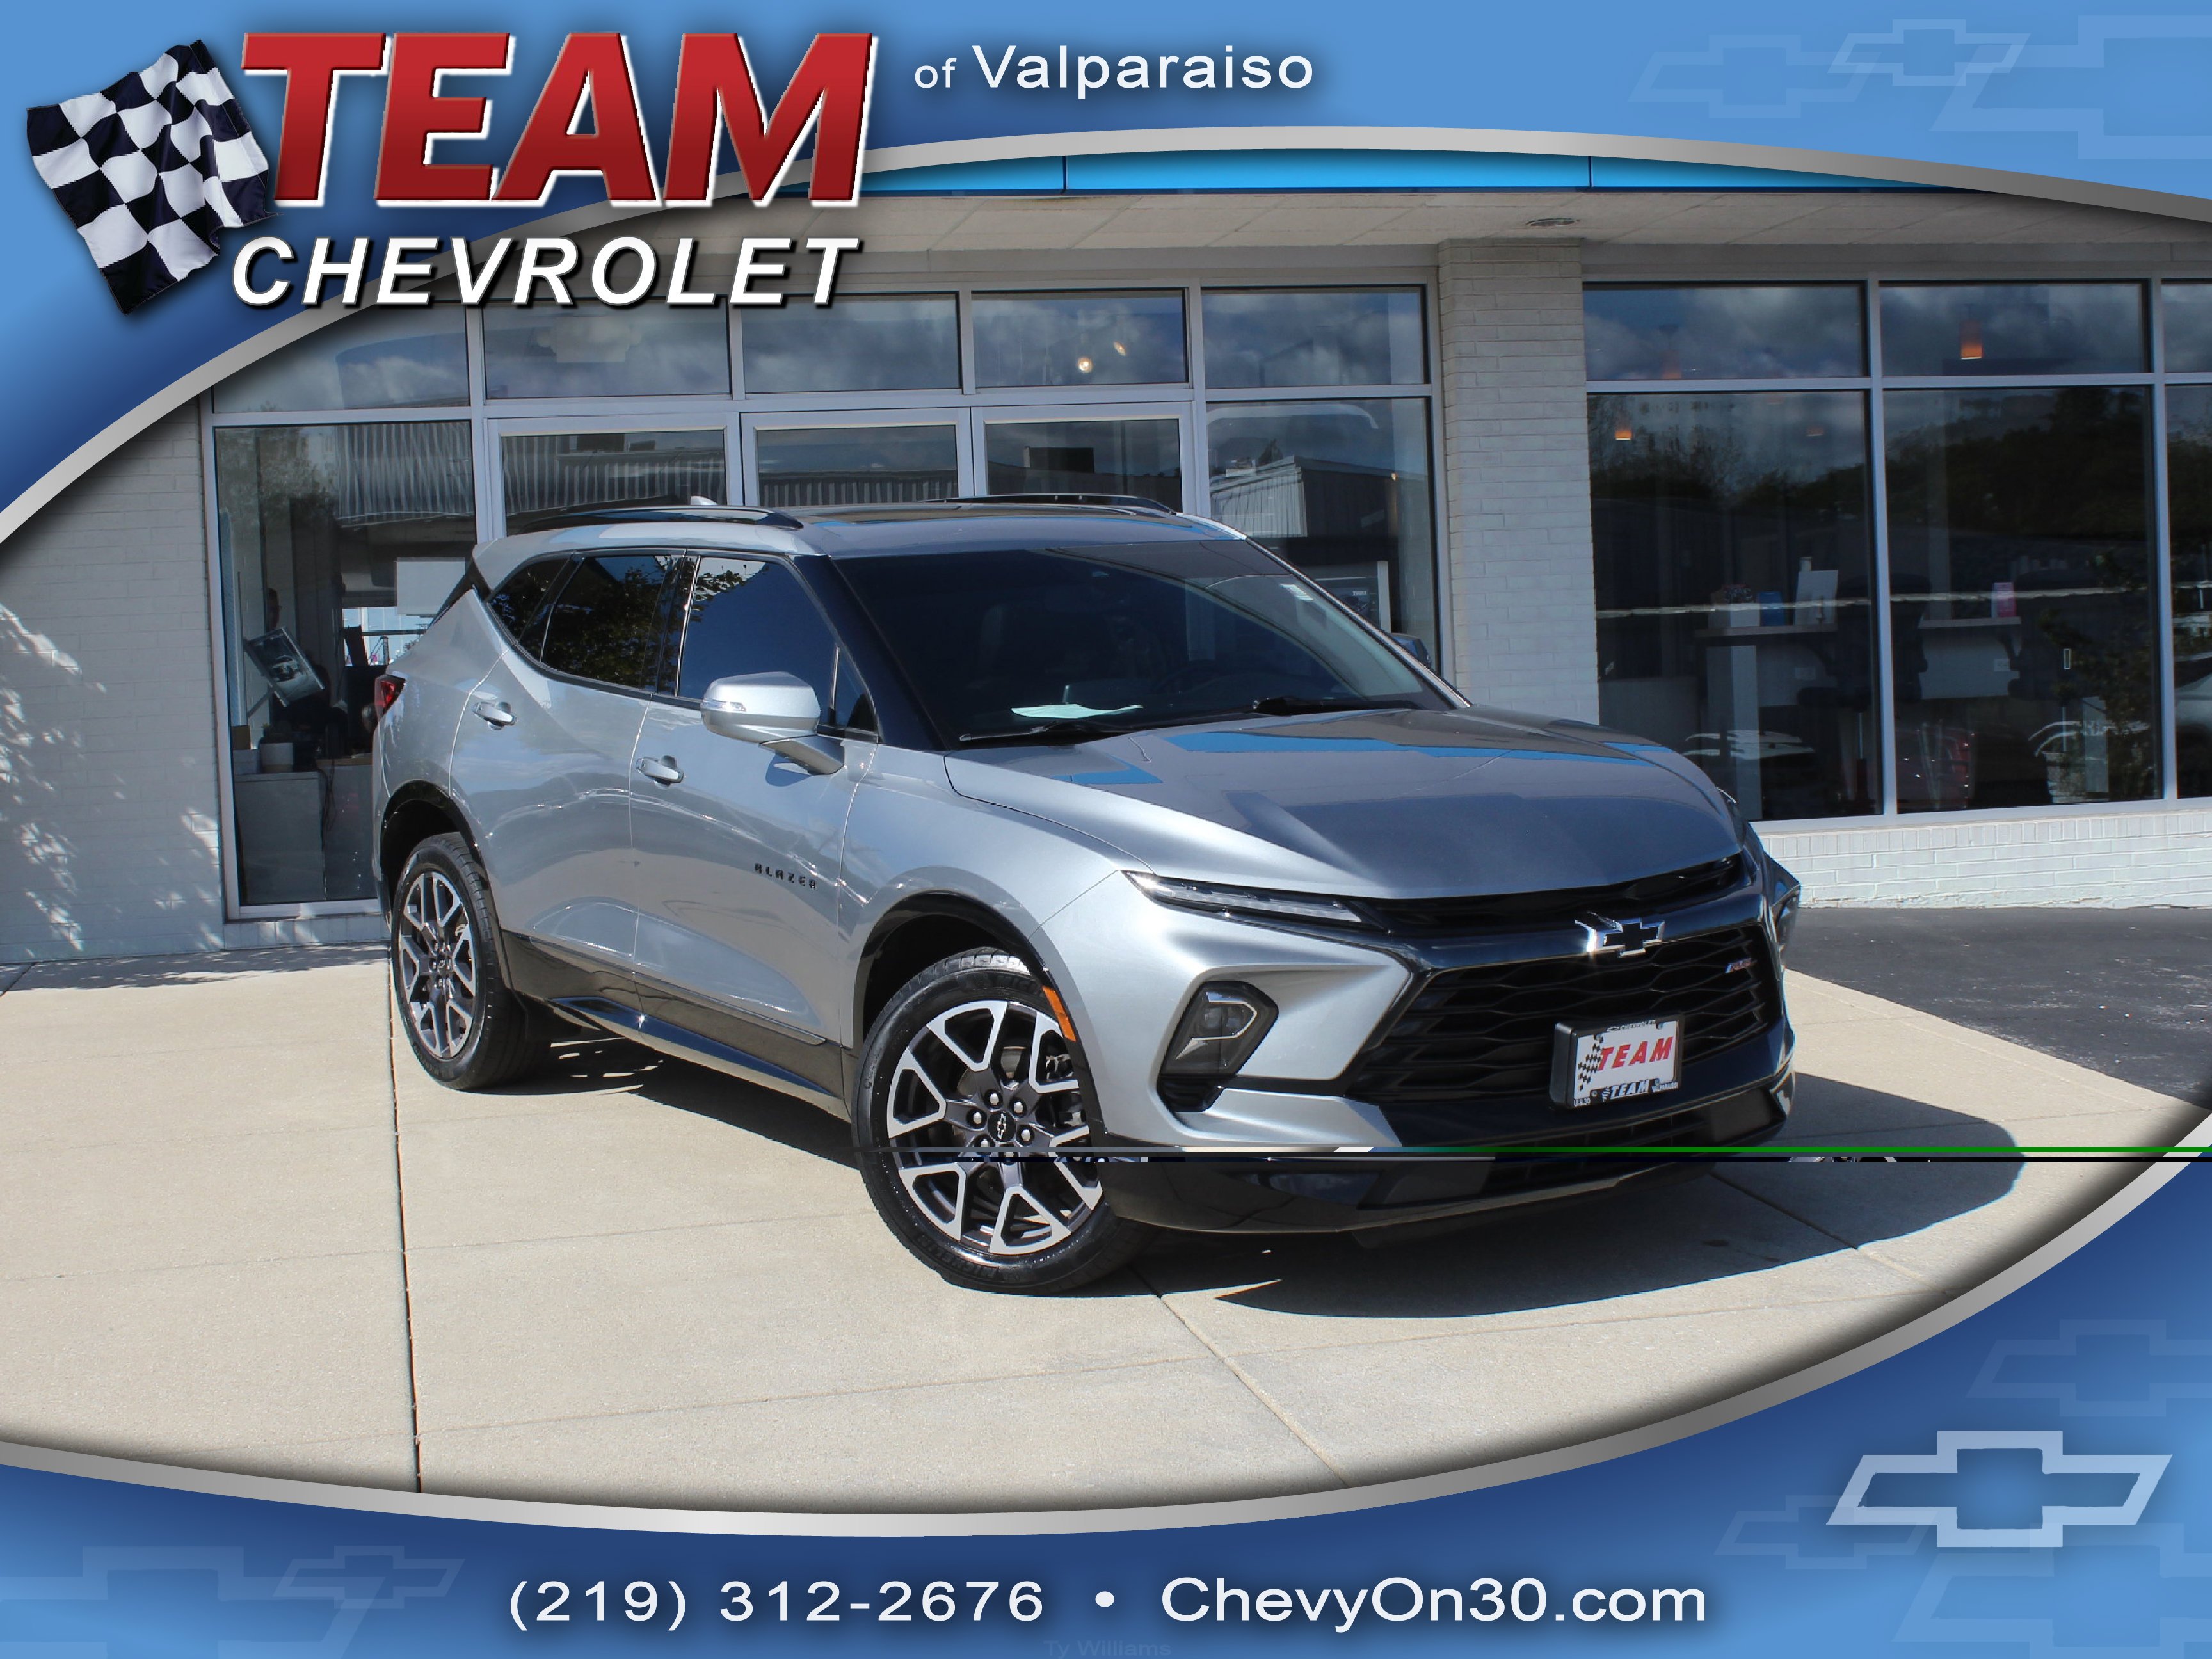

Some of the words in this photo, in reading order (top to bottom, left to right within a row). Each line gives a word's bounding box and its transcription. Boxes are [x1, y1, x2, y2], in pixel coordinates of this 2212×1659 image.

[754, 863, 817, 890] BLAZER
[1598, 1036, 1673, 1071] TEAM
[1610, 1079, 1649, 1099] TEAM
